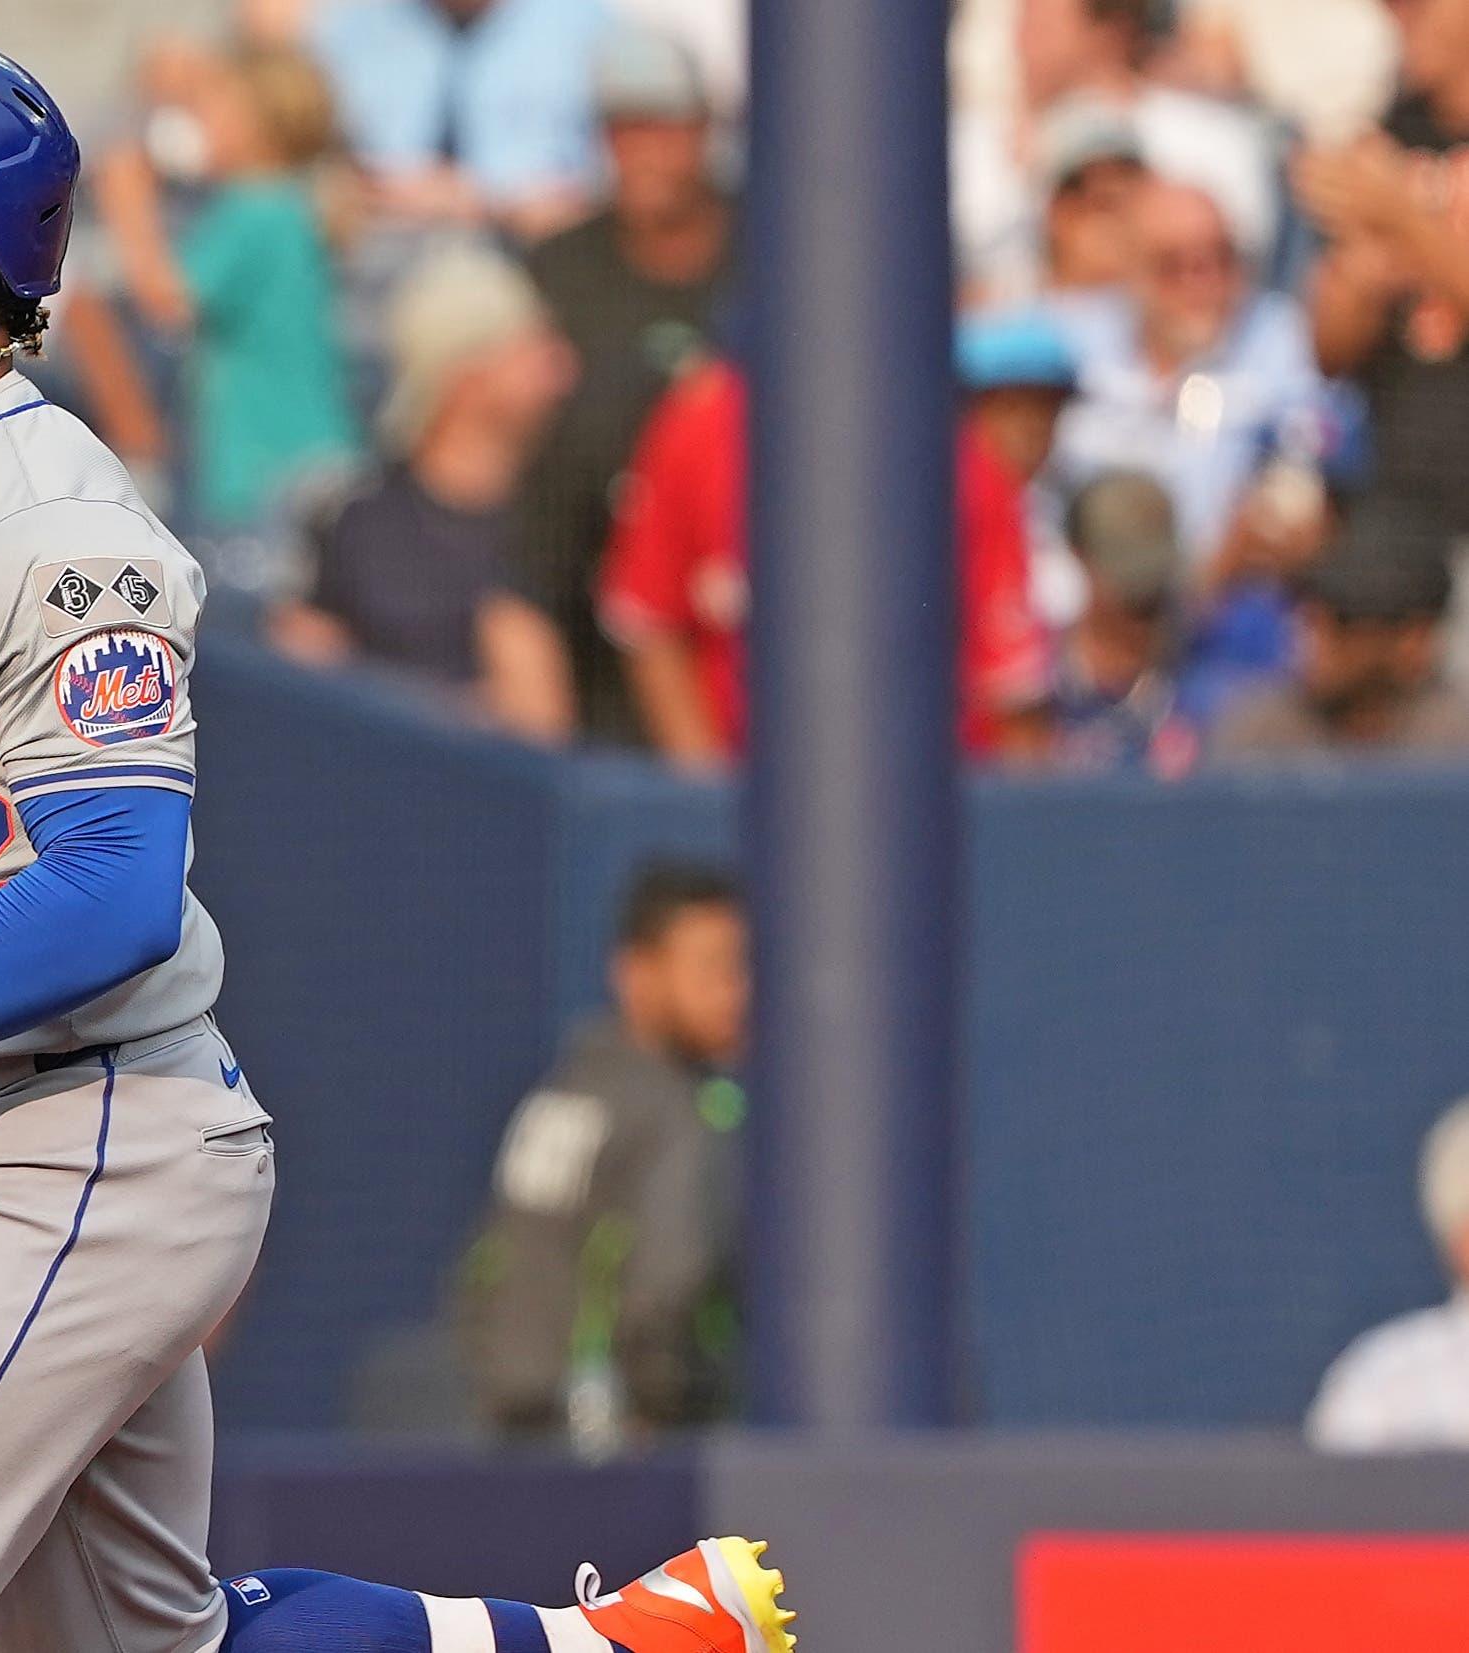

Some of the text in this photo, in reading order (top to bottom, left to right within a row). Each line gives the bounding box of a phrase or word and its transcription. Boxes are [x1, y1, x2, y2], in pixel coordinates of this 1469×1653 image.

[59, 573, 91, 615] 3
[120, 574, 150, 605] 15
[81, 664, 162, 720] Mets
